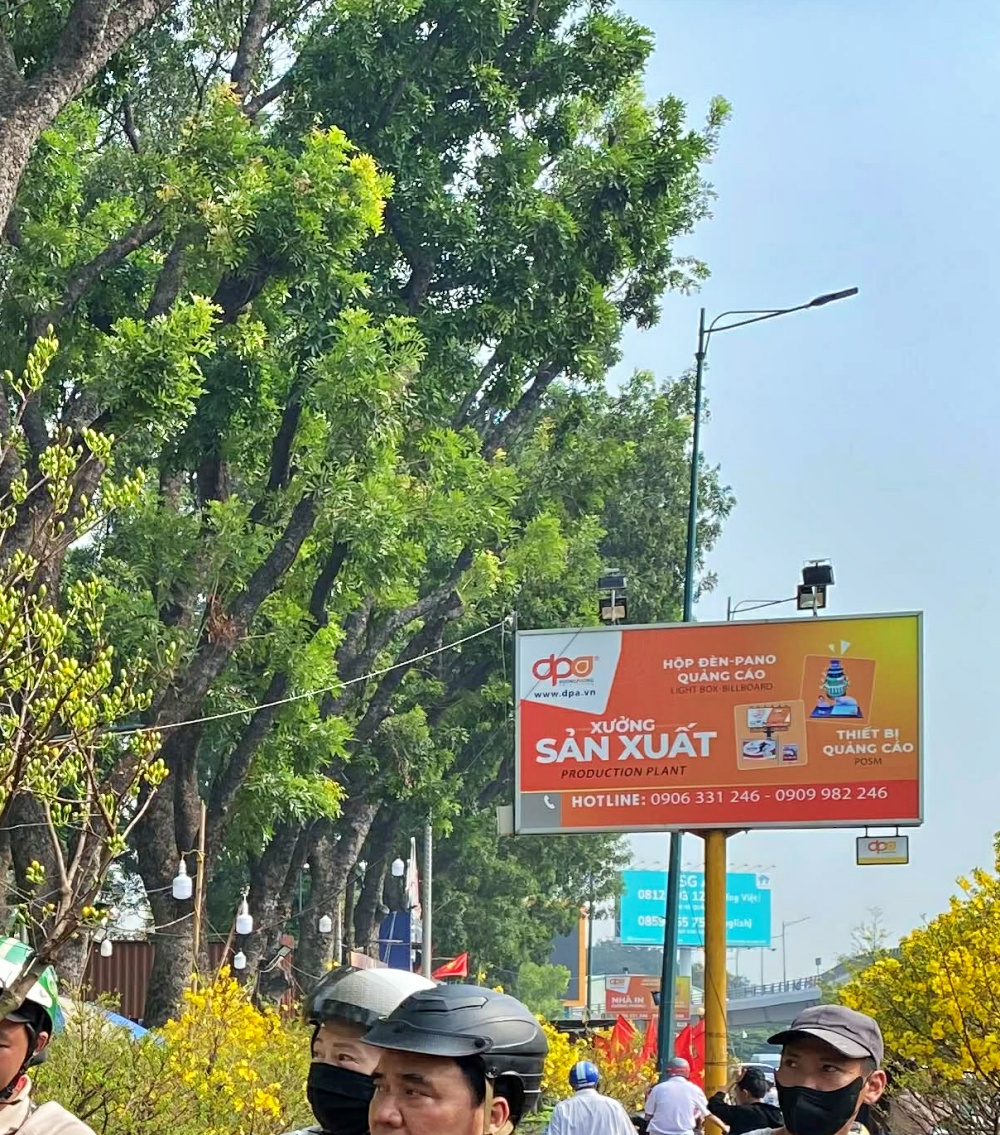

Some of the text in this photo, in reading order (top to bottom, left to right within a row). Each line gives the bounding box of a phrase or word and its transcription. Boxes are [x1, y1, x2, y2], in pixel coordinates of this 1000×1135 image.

[663, 654, 777, 671] HỘP ĐÈN-PANO
[677, 667, 766, 684] QUẢNG CÁO
[534, 690, 596, 698] www.dpa.vn
[671, 686, 697, 695] LIGHT
[590, 716, 655, 734] XƯỞNG
[837, 726, 900, 742] THIẾT BỊ
[536, 722, 718, 764] SẢN XUẤT
[823, 739, 914, 757] QUẢNG CÁO
[854, 756, 883, 767] POSM
[561, 765, 687, 780] PRODUCTION PLANT
[572, 794, 646, 808] HOTLINE:
[650, 792, 691, 806] 0906
[696, 791, 724, 804] 331
[730, 790, 760, 804] 246
[775, 788, 816, 802] 0909
[821, 787, 852, 801] 982
[857, 786, 888, 800] 246
[611, 995, 633, 1004] NHÀ
